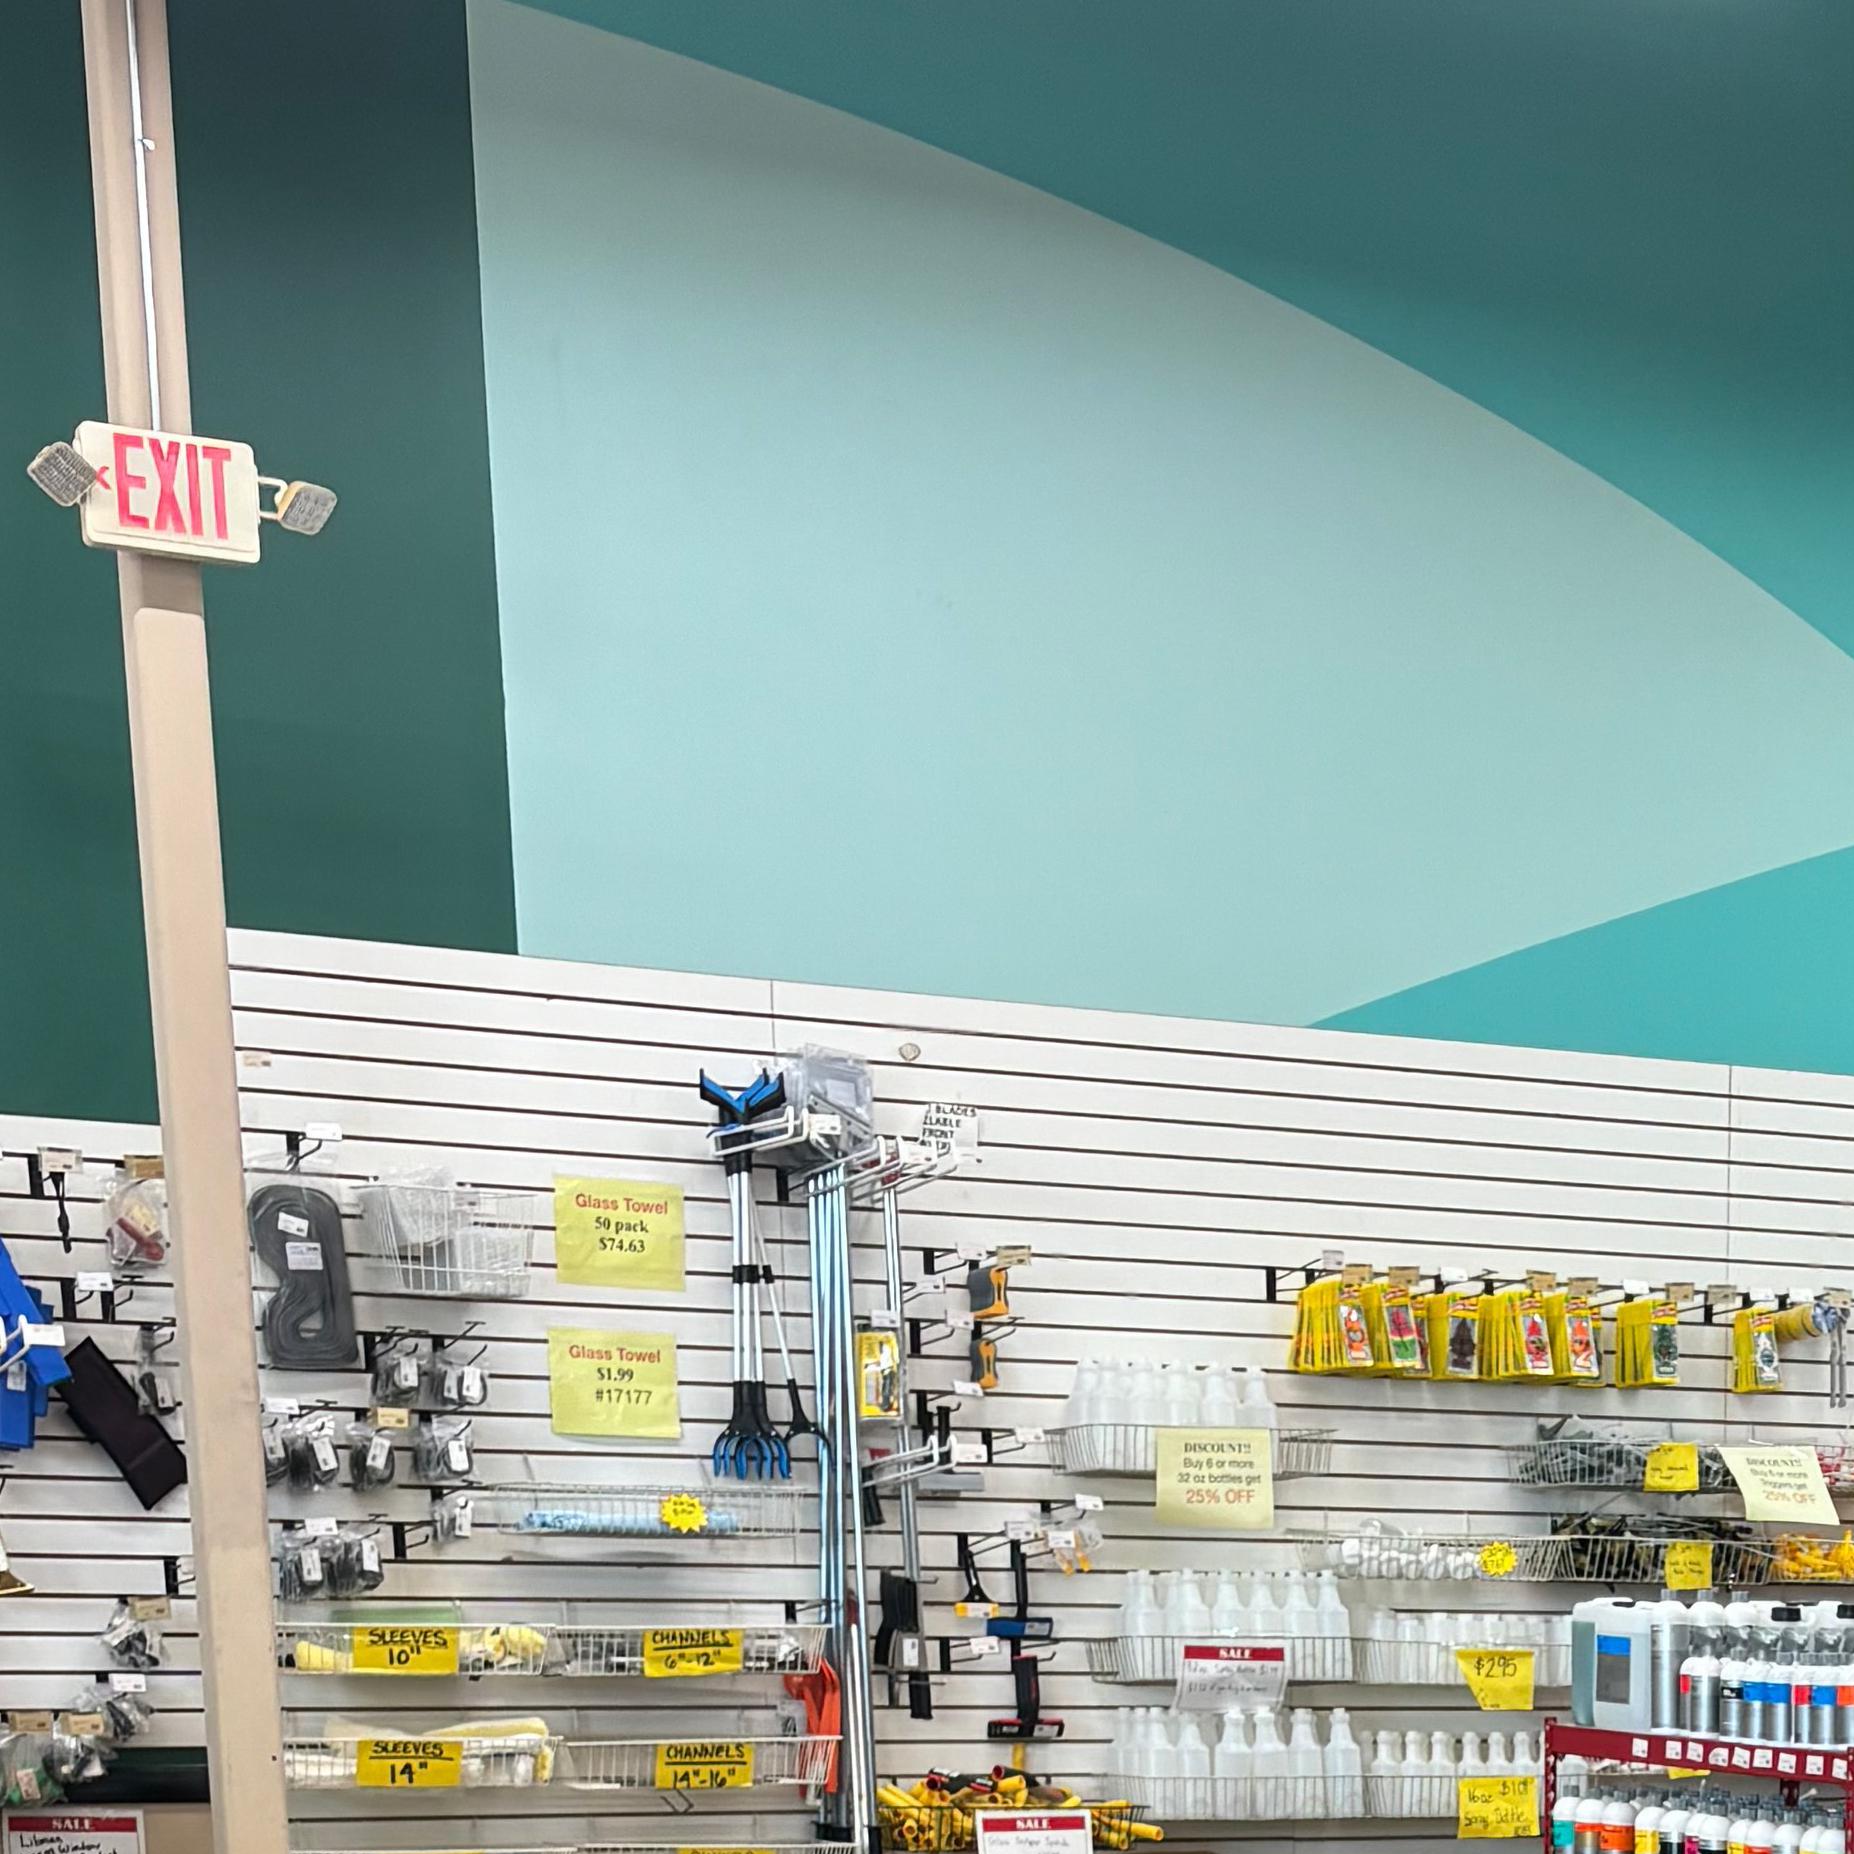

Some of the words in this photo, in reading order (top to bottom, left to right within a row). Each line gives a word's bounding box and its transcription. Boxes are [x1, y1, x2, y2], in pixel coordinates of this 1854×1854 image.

[113, 433, 232, 540] EXIT
[575, 1193, 619, 1211] Glass
[623, 1197, 668, 1215] Towel
[595, 1216, 611, 1231] 50
[615, 1220, 649, 1235] pack
[598, 1237, 645, 1254] $74.63
[568, 1344, 612, 1361] Glass
[616, 1347, 661, 1364] Towel
[597, 1367, 634, 1382] $1.99
[595, 1388, 652, 1406] #17177
[1183, 1458, 1204, 1471] Buy
[1215, 1460, 1226, 1469] or
[1228, 1460, 1255, 1469] more
[1208, 1473, 1243, 1484] bottles
[1245, 1474, 1262, 1486] get
[1185, 1488, 1221, 1504] 25%
[1224, 1489, 1255, 1504] OFF
[368, 1628, 448, 1646] SLEEVES
[652, 1630, 731, 1644] CHANNELS
[1219, 1648, 1253, 1659] SALE
[372, 1741, 444, 1757] SLEEVES
[666, 1743, 745, 1759] CHANNELS
[52, 1818, 94, 1830] SALE
[1015, 1818, 1051, 1829] SALE
